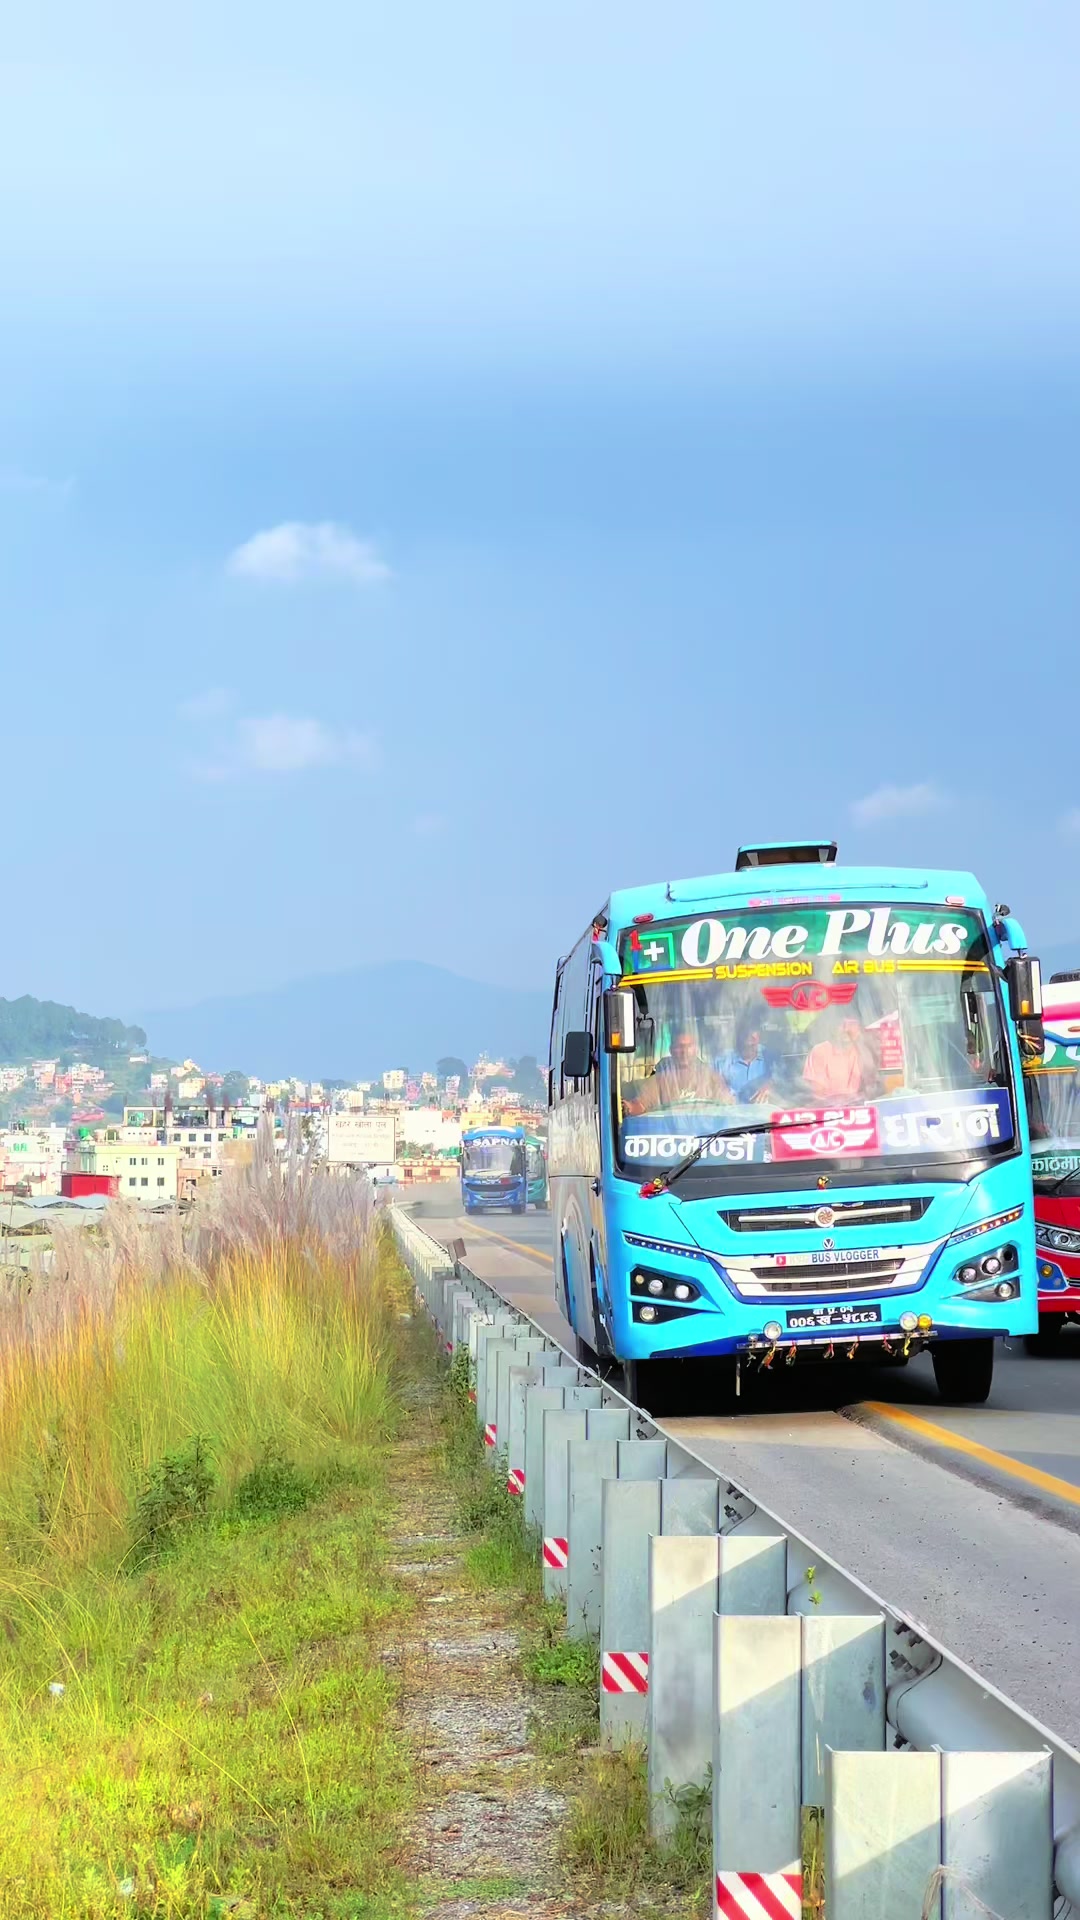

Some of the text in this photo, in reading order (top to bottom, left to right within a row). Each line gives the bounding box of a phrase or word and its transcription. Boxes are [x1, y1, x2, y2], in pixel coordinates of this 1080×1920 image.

[681, 907, 968, 967] One Plus
[715, 959, 896, 980] SUSPENSION AIR BUS
[823, 1109, 871, 1127] BUS
[814, 1130, 841, 1148] A/C
[811, 1252, 831, 1263] BUS
[834, 1249, 880, 1262] VLOGGER
